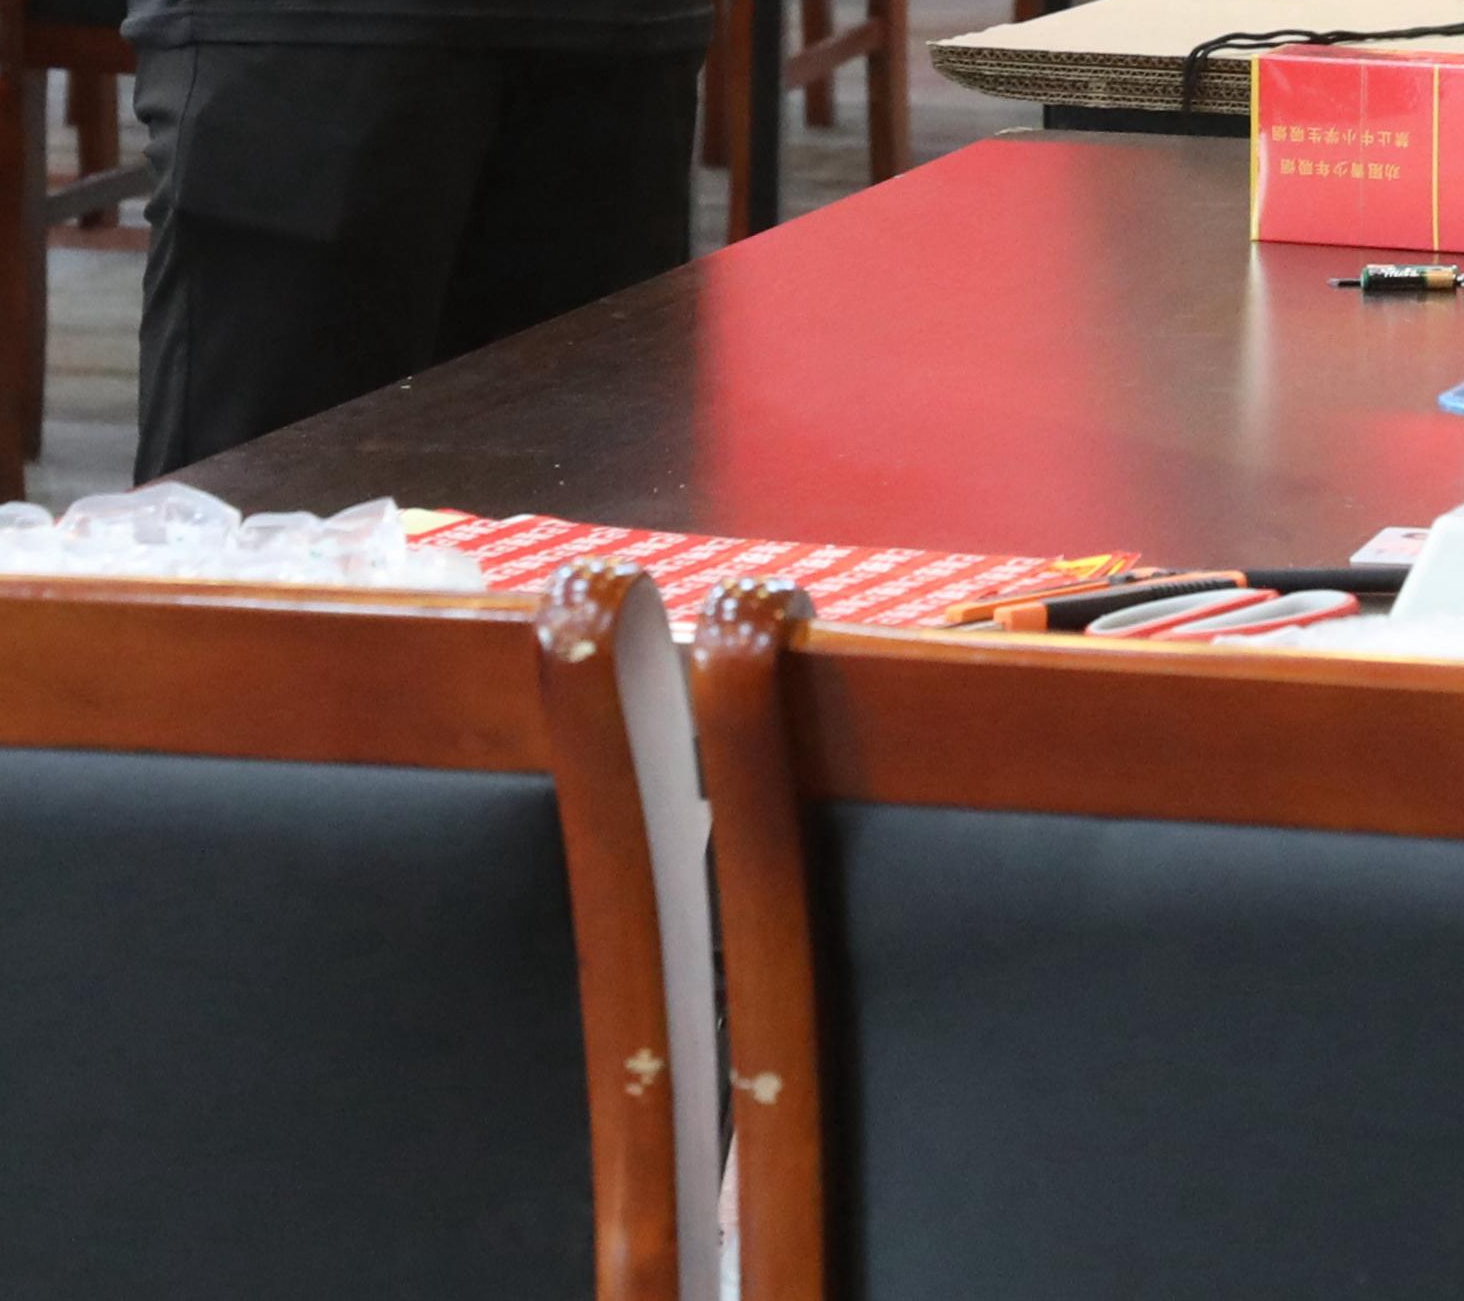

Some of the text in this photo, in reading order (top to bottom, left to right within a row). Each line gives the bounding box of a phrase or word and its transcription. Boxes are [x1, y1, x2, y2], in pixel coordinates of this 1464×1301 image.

[1271, 125, 1410, 148] 禁止中小学生吸烟
[1280, 158, 1401, 180] 劝阻青少年吸烟
